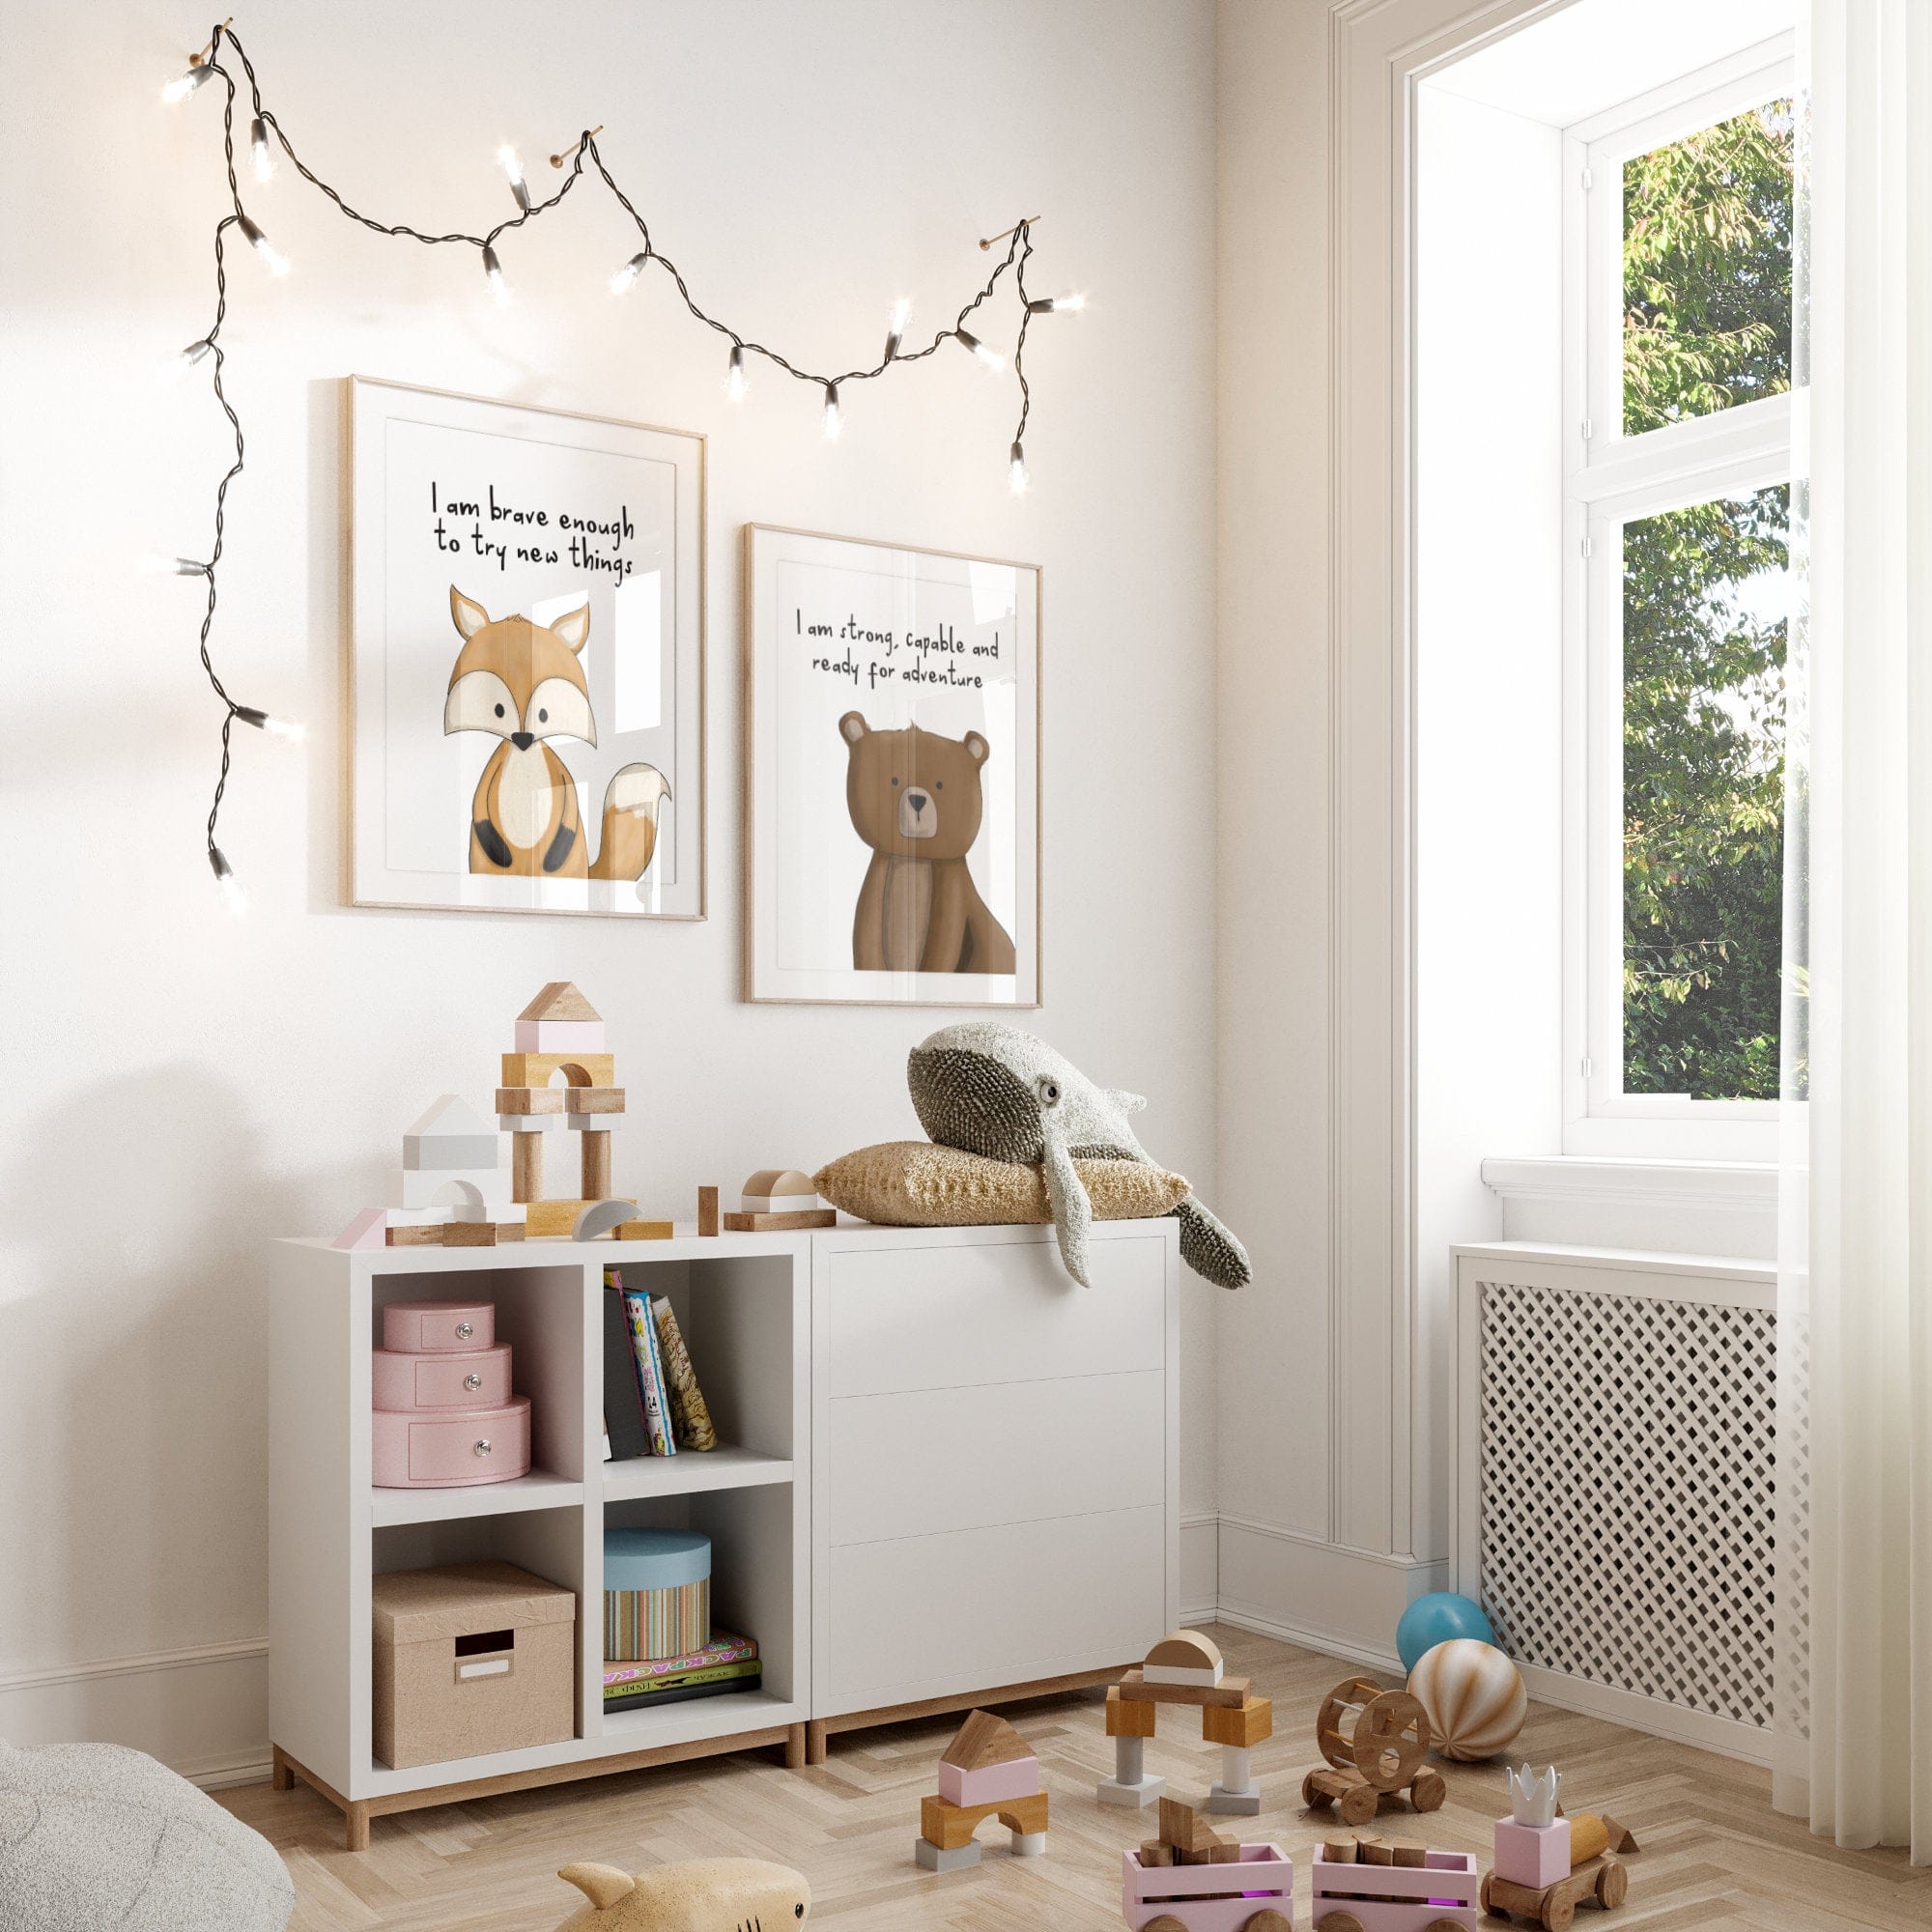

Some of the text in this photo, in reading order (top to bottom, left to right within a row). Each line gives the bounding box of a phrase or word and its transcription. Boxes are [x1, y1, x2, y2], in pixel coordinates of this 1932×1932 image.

[432, 481, 635, 552] I am brave enough
[433, 518, 634, 588] to try new things
[797, 609, 999, 660] I am strong, capable and
[812, 647, 983, 691] ready for adventure
